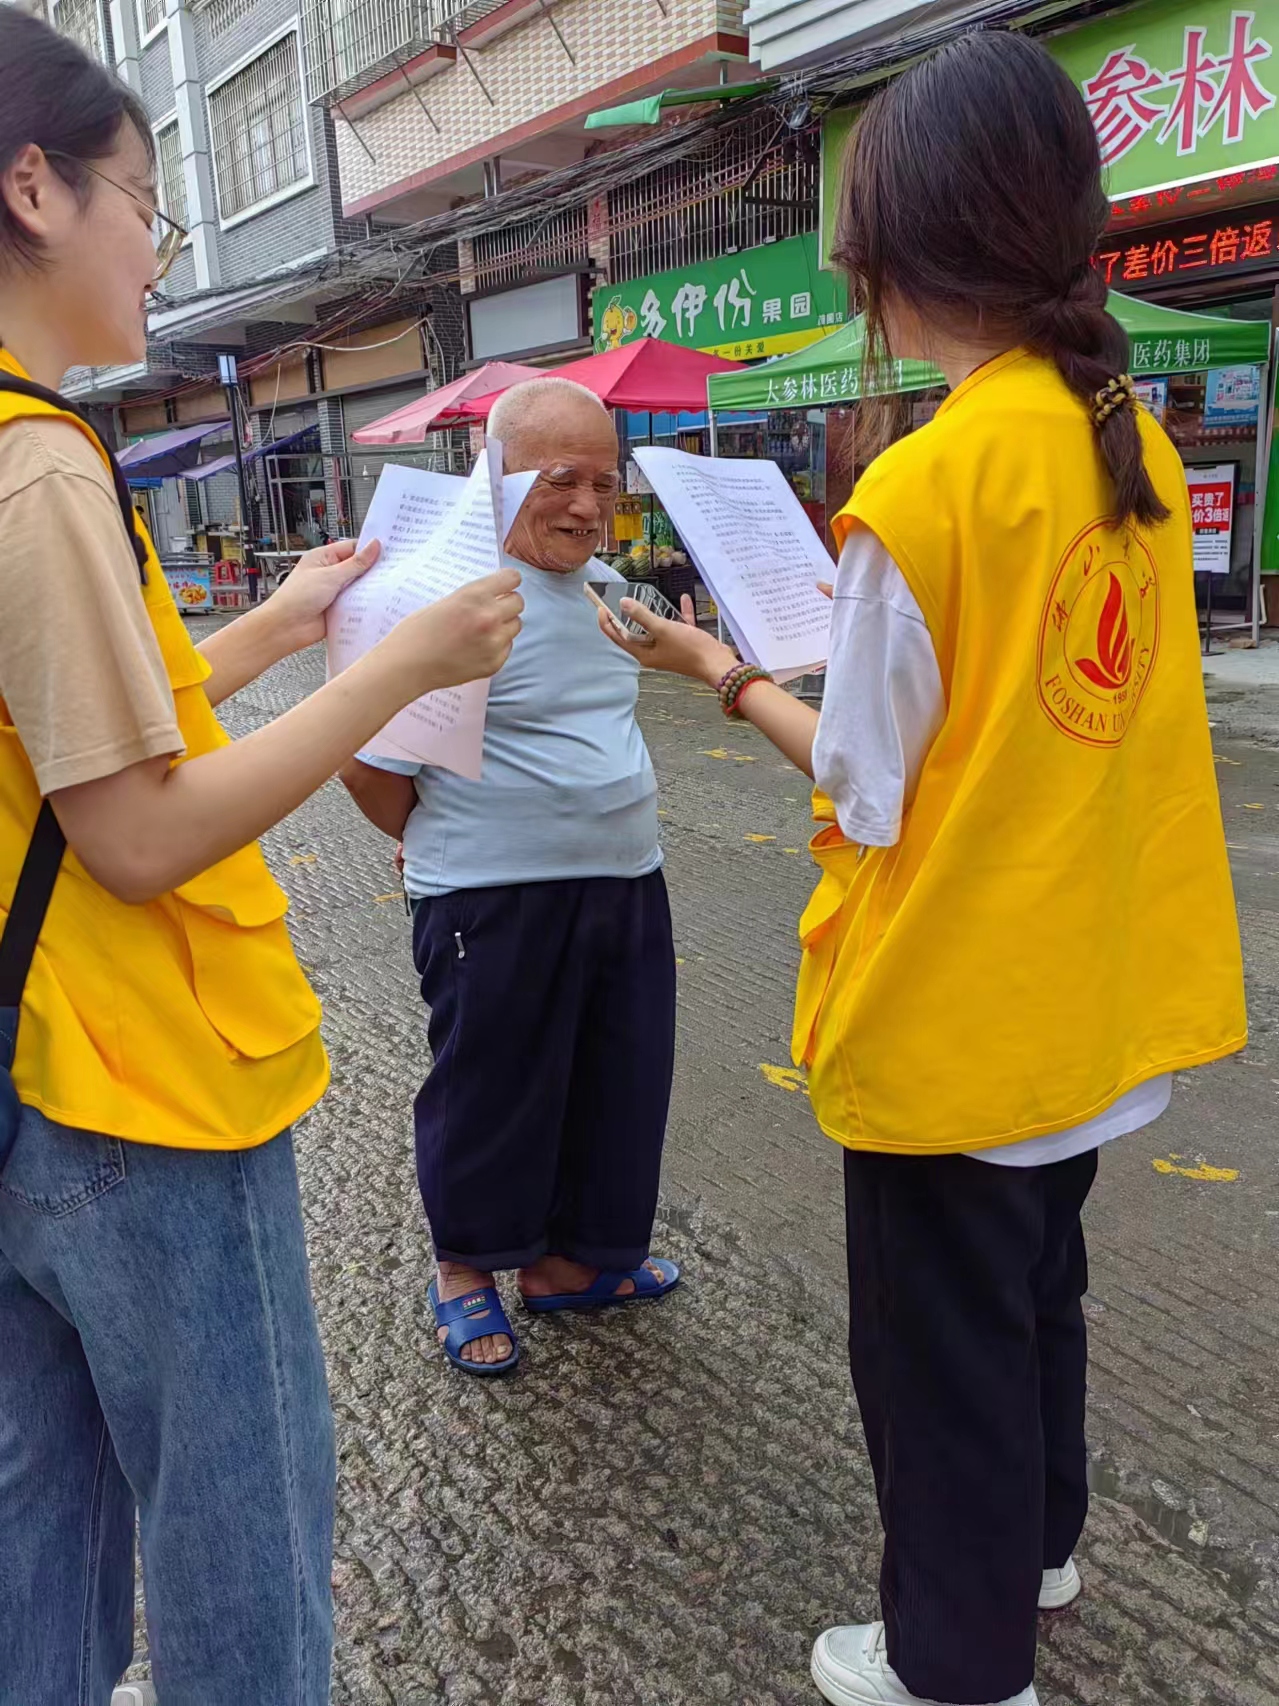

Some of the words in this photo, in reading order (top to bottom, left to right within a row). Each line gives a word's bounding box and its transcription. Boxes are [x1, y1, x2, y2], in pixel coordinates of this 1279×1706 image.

[1082, 10, 1277, 168] 参林
[1089, 219, 1279, 284] 了差价三倍返
[639, 268, 757, 339] 多伊份
[762, 291, 811, 324] 果园
[1132, 338, 1210, 369] 医药集团
[763, 359, 903, 405] 大参林医药
[1191, 491, 1224, 508] 买贵了
[1191, 506, 1230, 523] 价3倍返
[1044, 673, 1107, 733] FOSHAN
